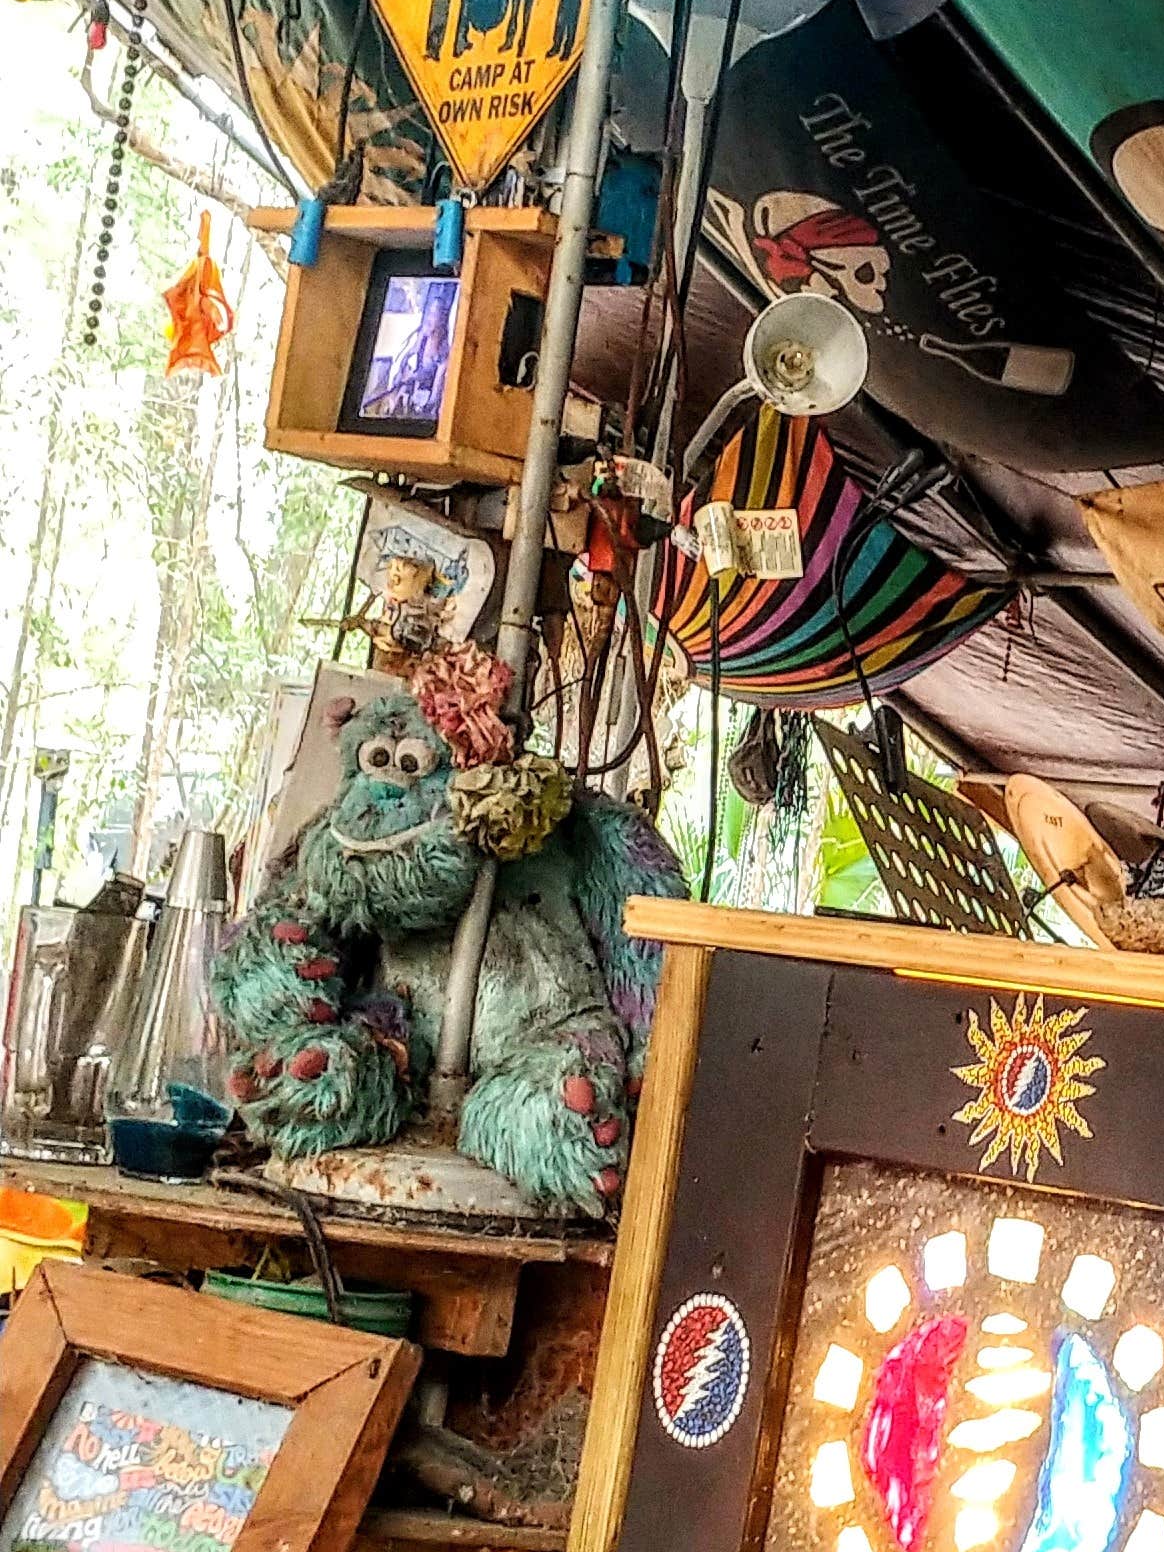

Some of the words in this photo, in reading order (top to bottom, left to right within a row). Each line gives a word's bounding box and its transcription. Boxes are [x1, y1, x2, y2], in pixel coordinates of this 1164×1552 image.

[449, 63, 506, 92] CAMP
[509, 58, 536, 86] AT
[439, 97, 484, 124] OWN
[488, 90, 536, 120] RISK
[799, 92, 872, 169] The
[854, 165, 936, 255] Time
[921, 252, 1006, 337] Flies
